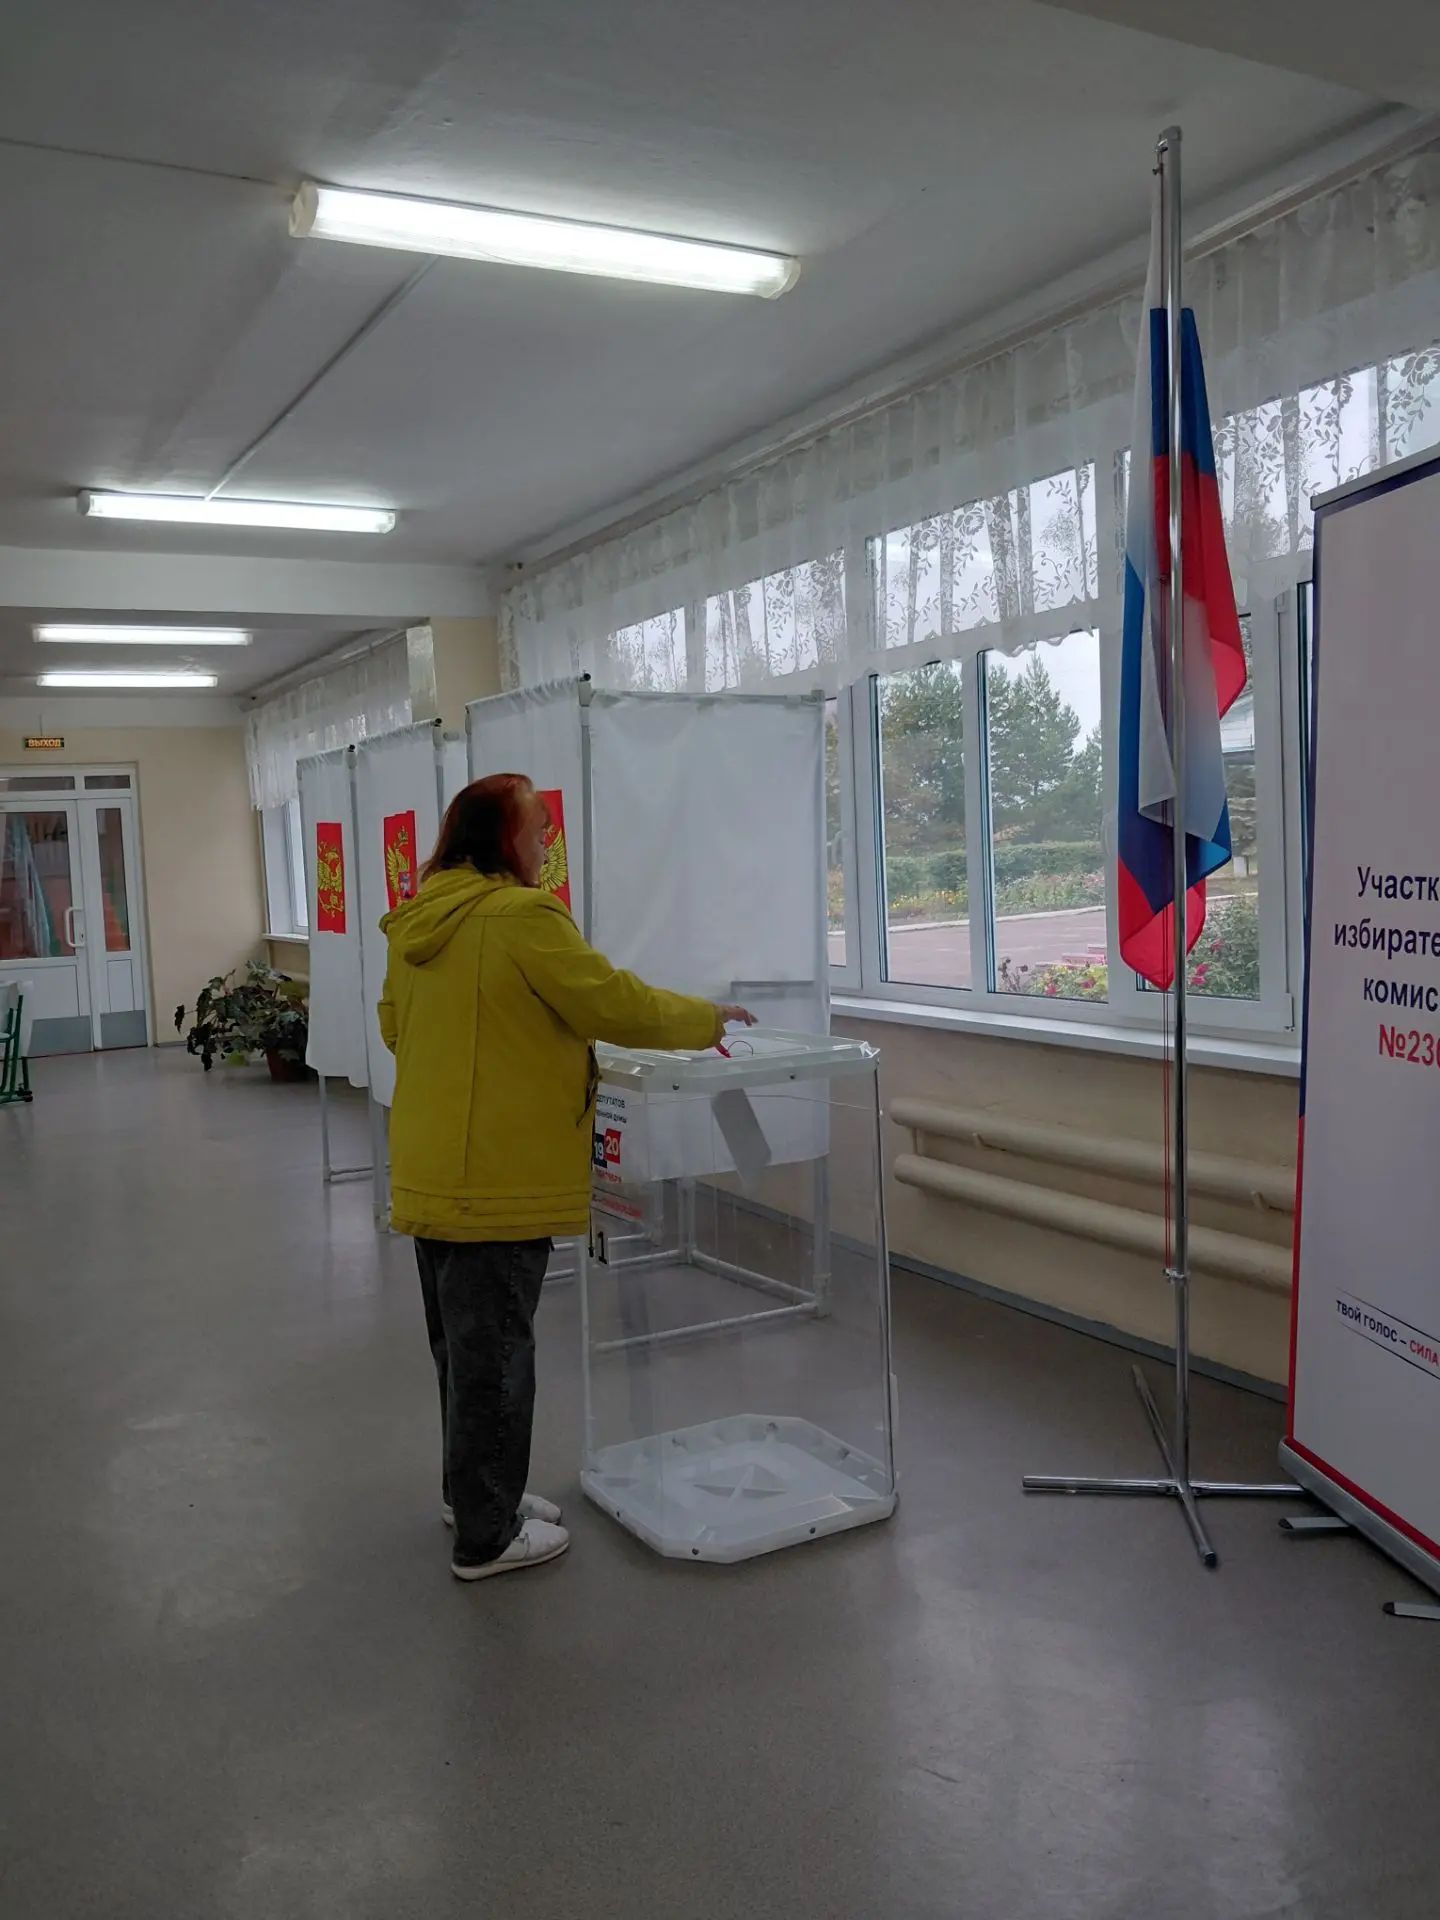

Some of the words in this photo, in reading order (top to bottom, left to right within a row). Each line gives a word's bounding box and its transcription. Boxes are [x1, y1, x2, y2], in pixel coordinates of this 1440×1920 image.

[28, 739, 61, 747] ВЫХОД
[1357, 865, 1440, 902] Участк
[1334, 917, 1440, 960] избирате
[1379, 1024, 1440, 1069] №23
[605, 1135, 619, 1156] 20
[1364, 1315, 1397, 1342] ГОЛОС
[1409, 1339, 1440, 1367] СИЛА
